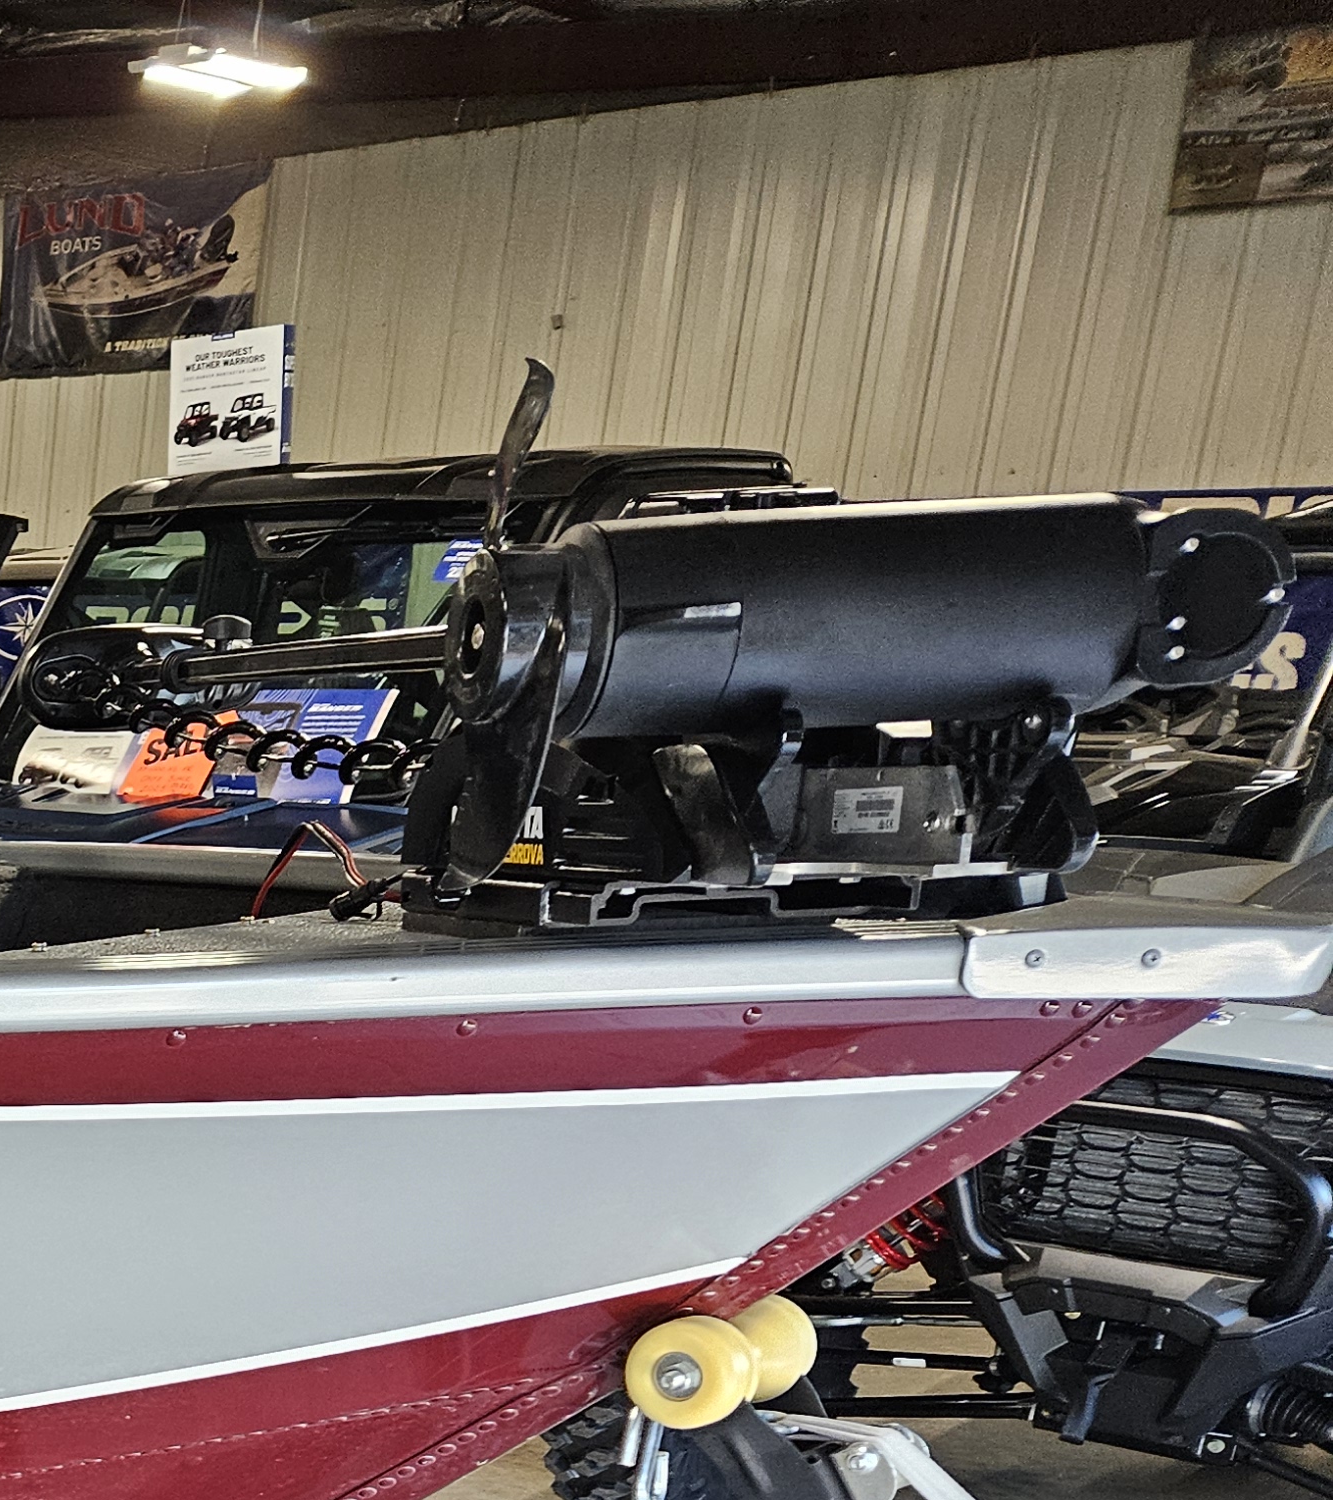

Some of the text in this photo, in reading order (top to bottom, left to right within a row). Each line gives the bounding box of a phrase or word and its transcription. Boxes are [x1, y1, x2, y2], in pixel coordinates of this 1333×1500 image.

[17, 192, 145, 248] LUND
[50, 235, 103, 256] BOATS
[185, 354, 267, 373] WEATHER WARRIORS
[195, 346, 254, 363] OUR TOUGHEST
